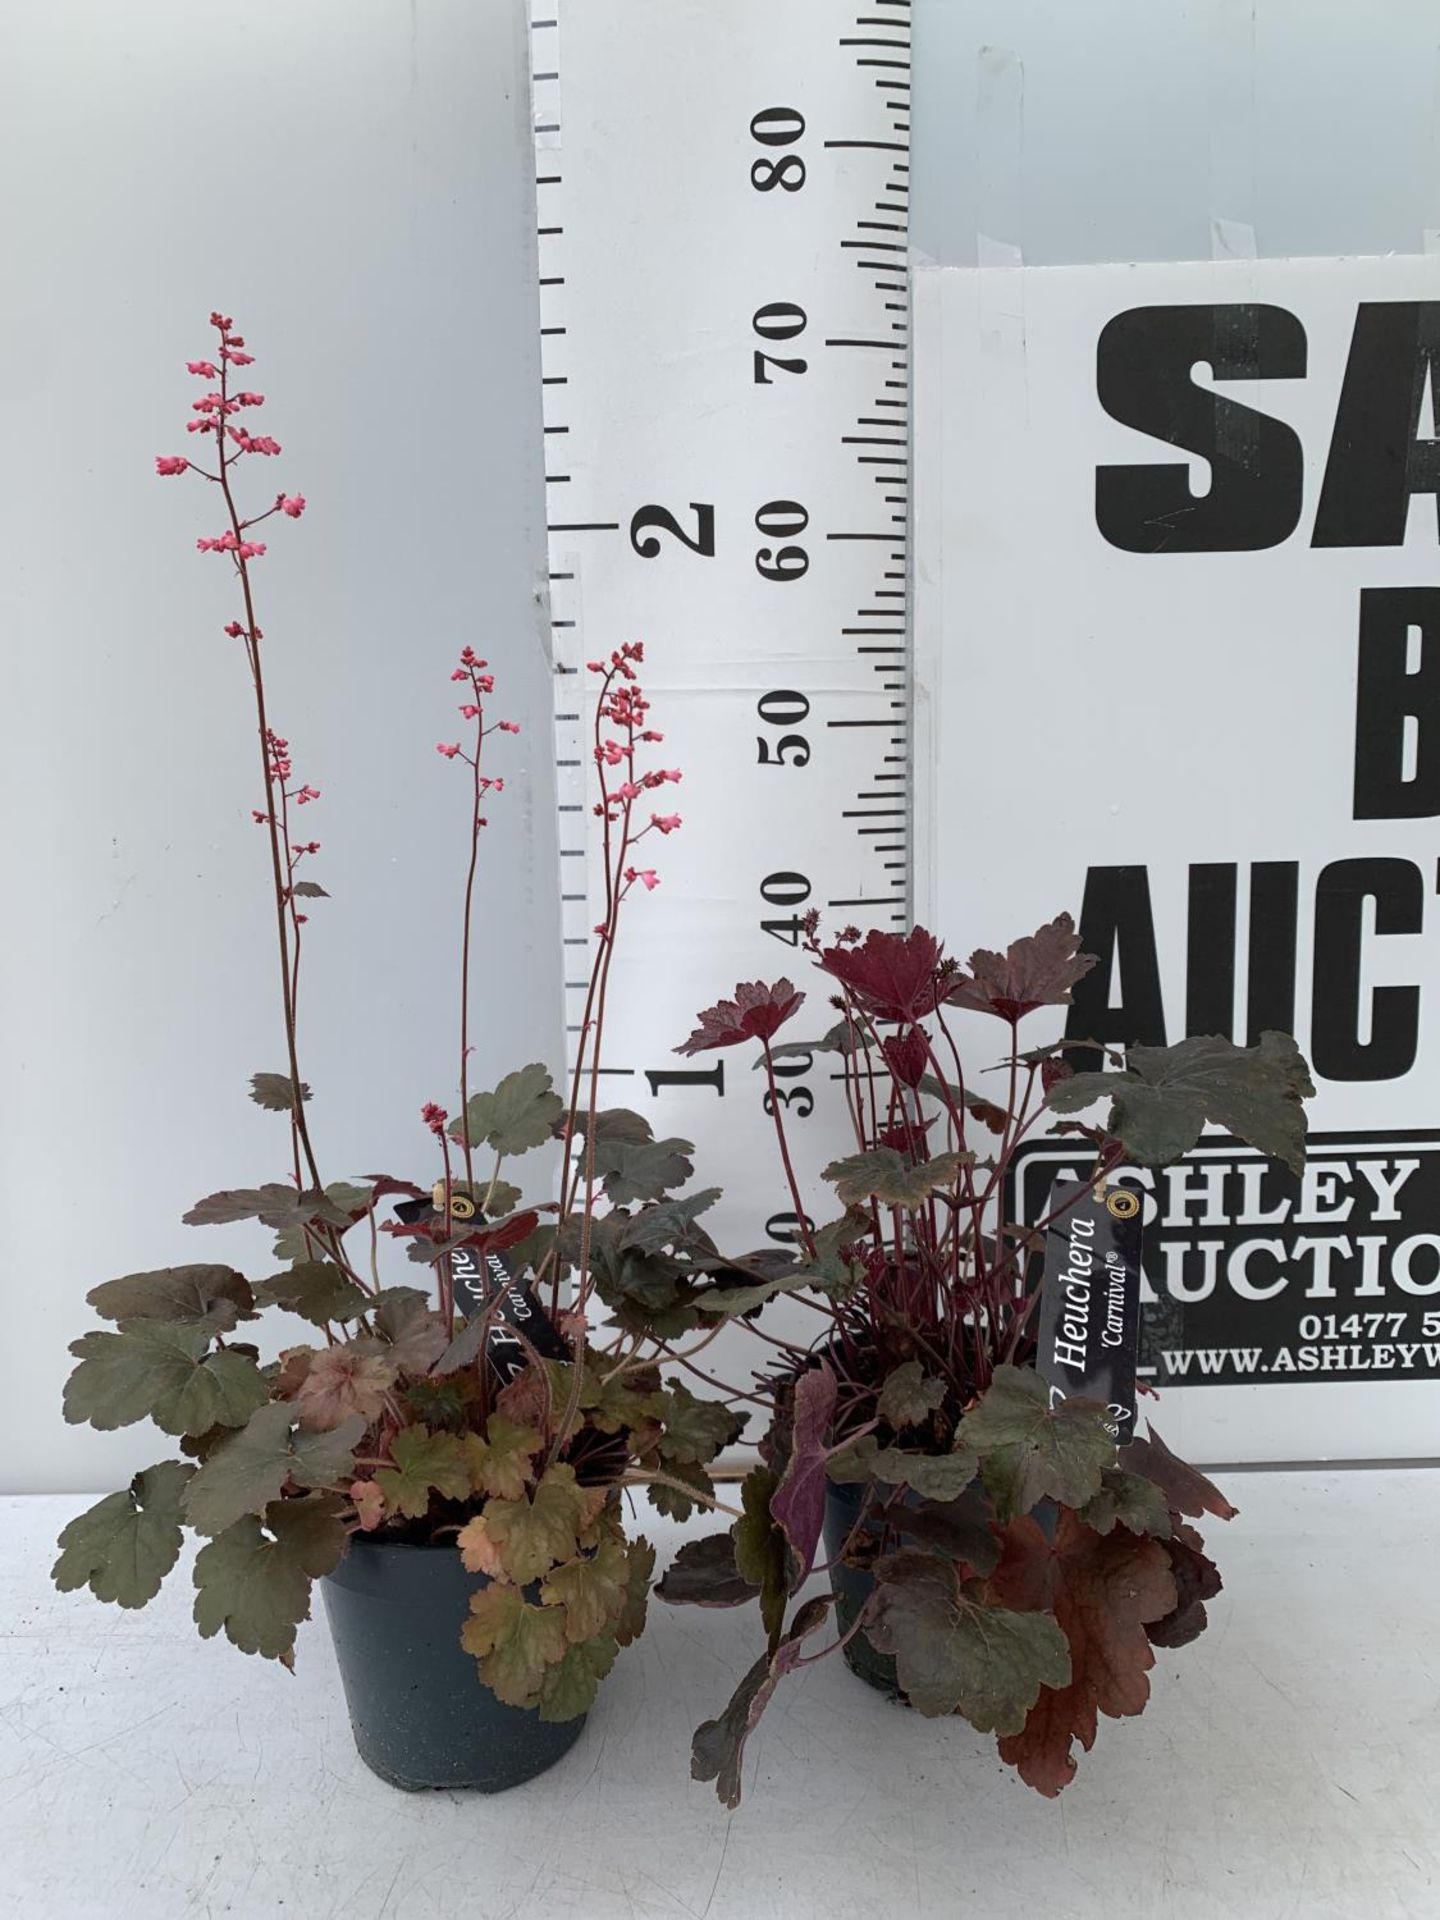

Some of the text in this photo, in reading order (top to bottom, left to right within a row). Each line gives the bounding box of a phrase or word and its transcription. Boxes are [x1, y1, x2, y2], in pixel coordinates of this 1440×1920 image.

[750, 106, 807, 193] 80
[752, 302, 808, 385] 70
[630, 502, 716, 560] 2
[755, 499, 810, 582] 60
[757, 688, 812, 768] 50
[760, 871, 812, 947] 40
[1061, 856, 1440, 1083] AUC
[644, 1059, 724, 1098] 1
[1053, 1217, 1096, 1374] Heuchera
[1140, 1233, 1440, 1303] UCTIO
[1299, 1312, 1408, 1341] 01477
